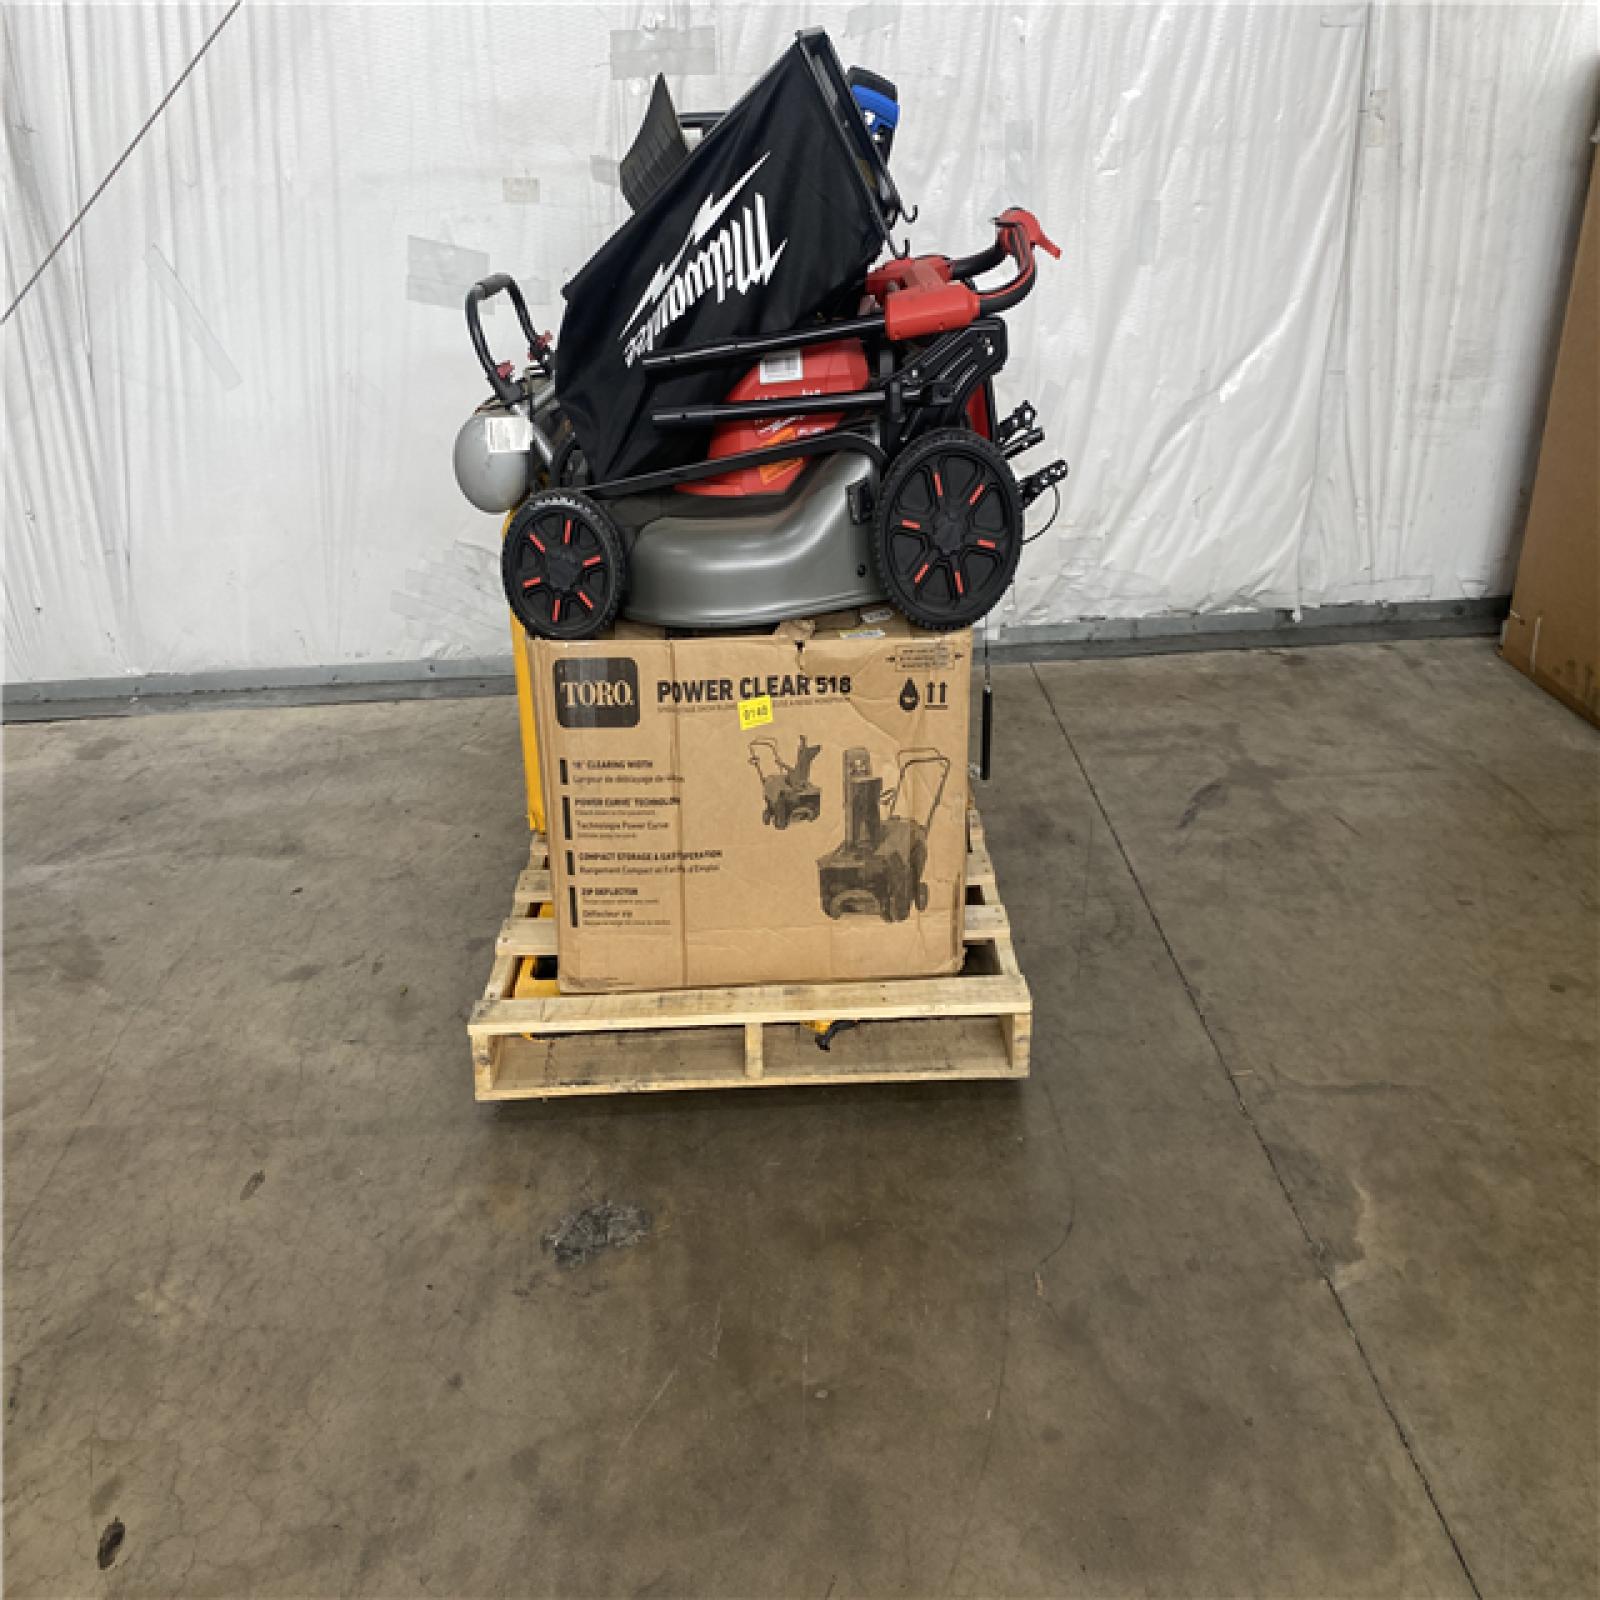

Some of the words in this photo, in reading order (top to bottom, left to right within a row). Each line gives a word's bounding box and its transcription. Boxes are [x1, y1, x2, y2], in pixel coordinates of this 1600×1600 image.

[657, 679, 733, 704] POWER
[739, 675, 811, 700] CLEAR
[815, 675, 852, 694] 518
